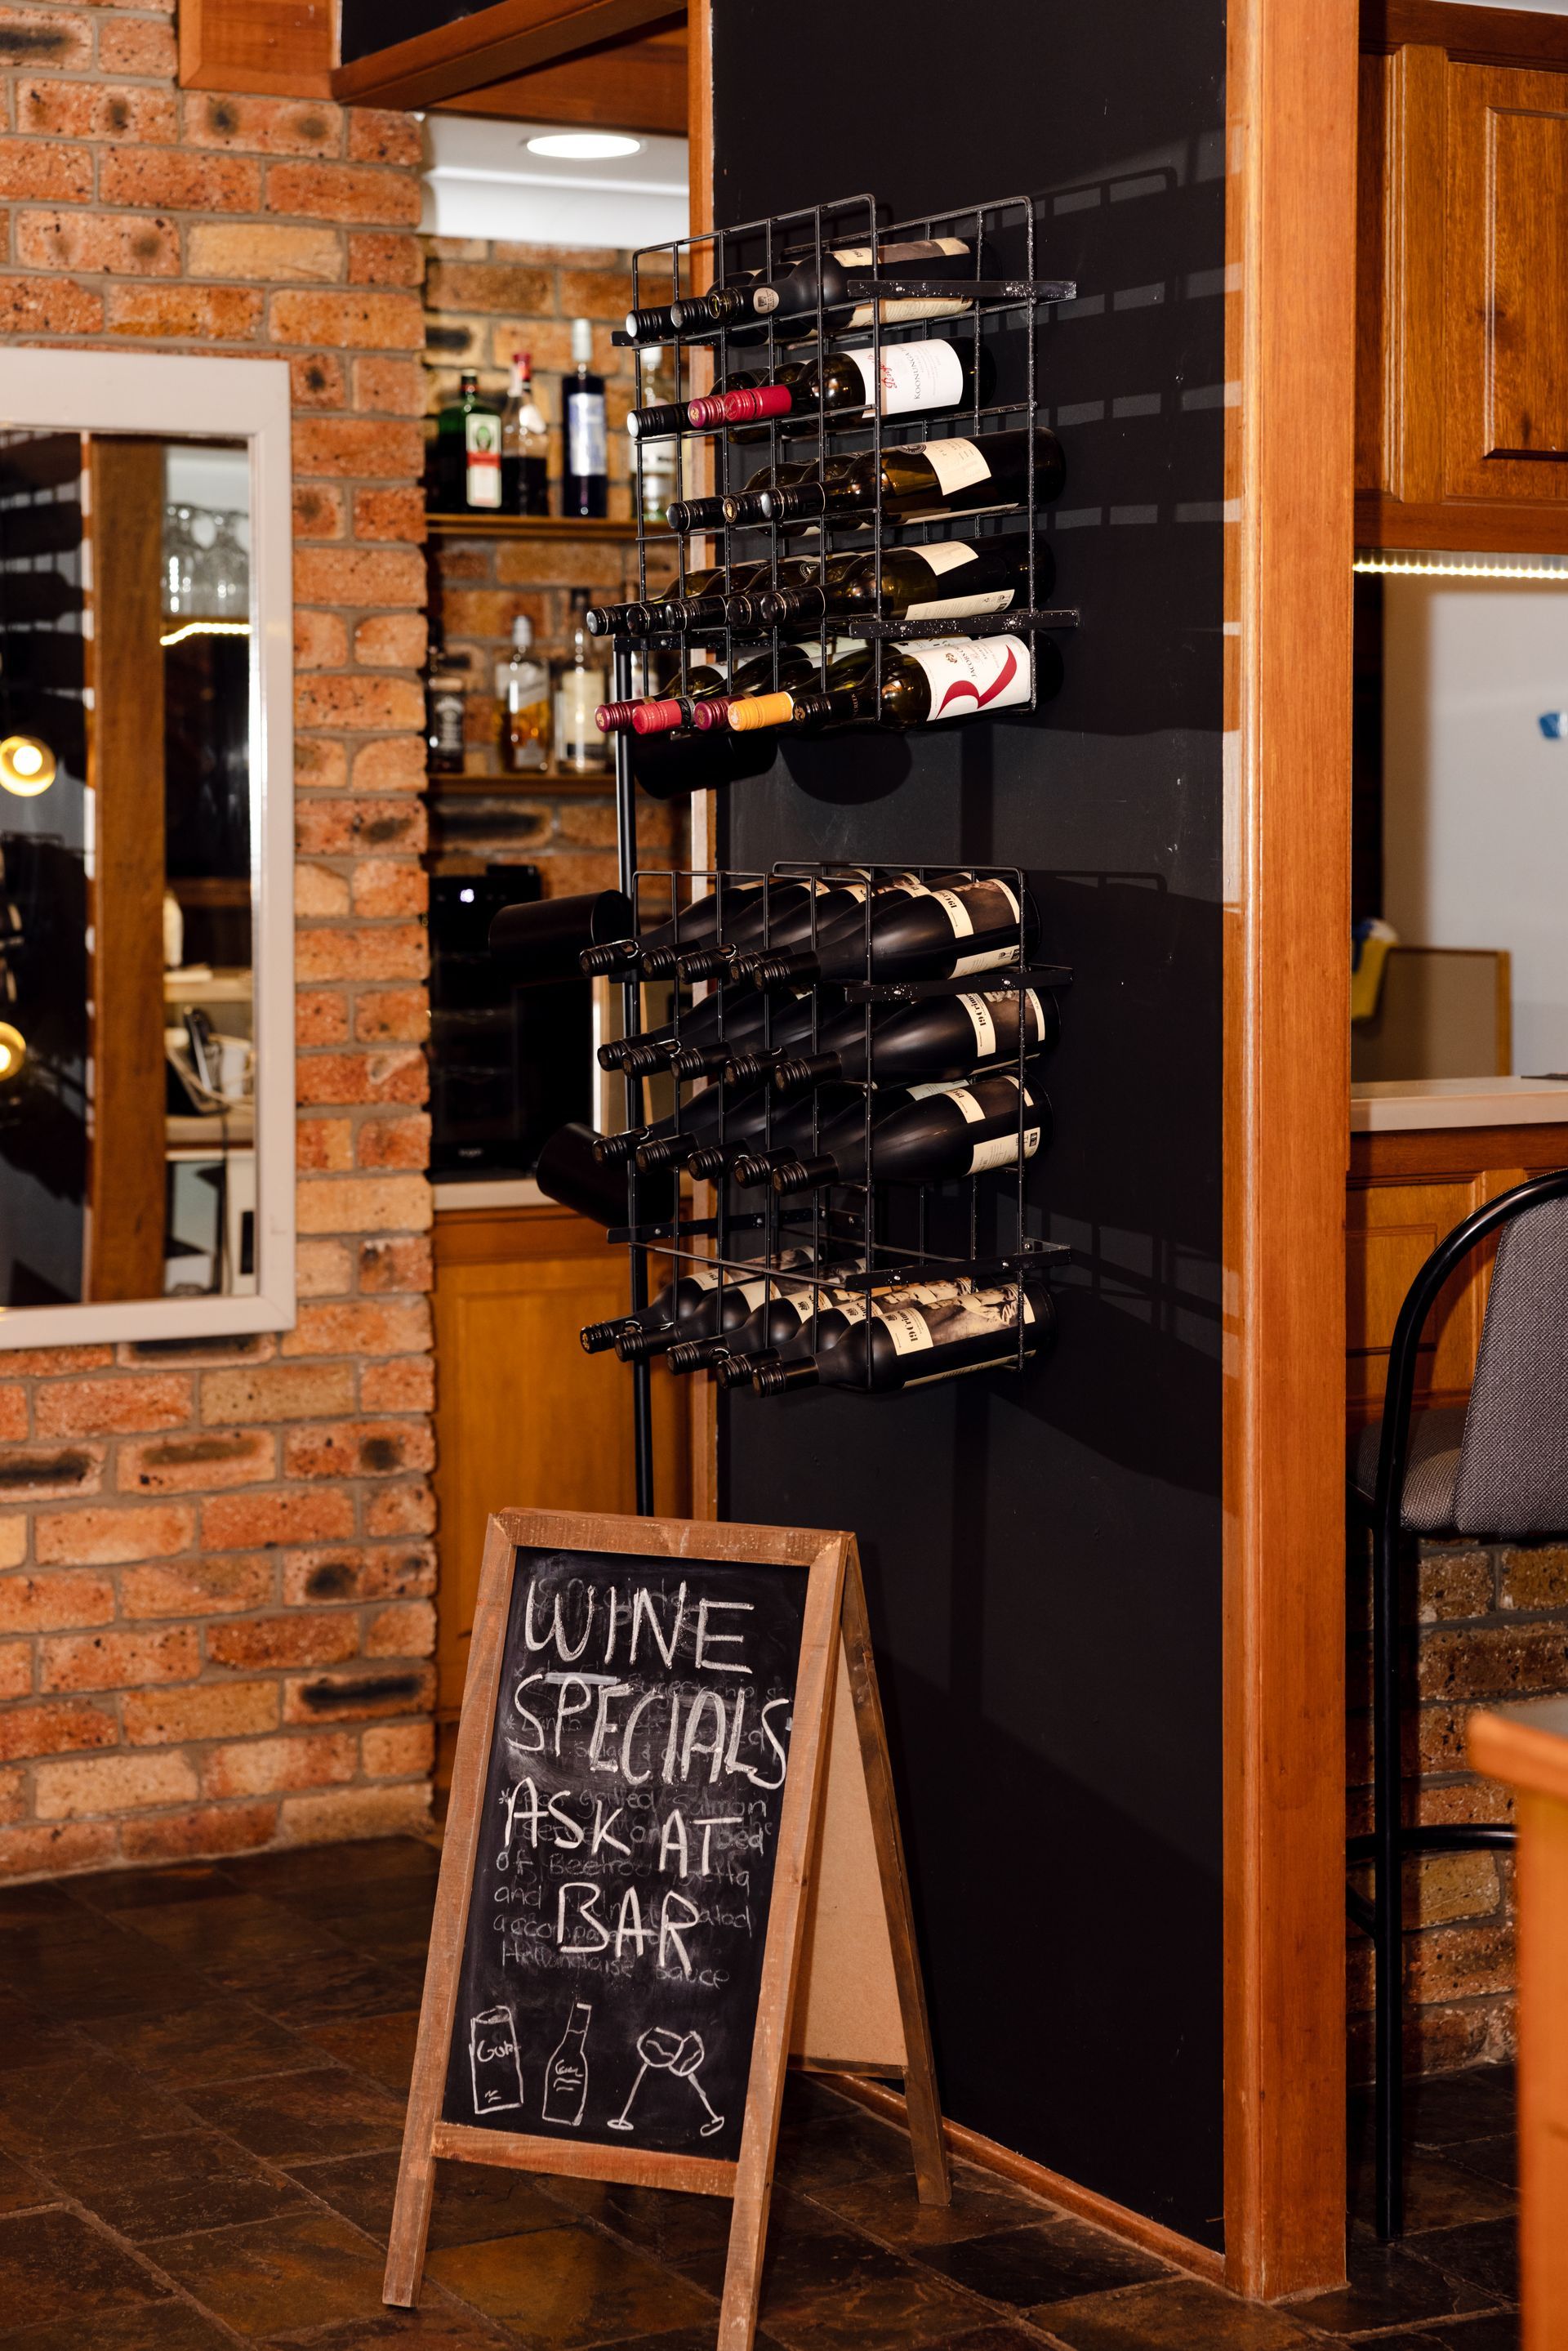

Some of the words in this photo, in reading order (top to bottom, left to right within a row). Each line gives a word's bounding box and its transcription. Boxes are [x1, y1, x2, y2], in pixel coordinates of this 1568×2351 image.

[908, 1330, 919, 1342] 19
[525, 1579, 755, 1673] WINE
[505, 1674, 790, 1790] SPECIALS
[505, 1777, 631, 1855] ASK
[660, 1809, 743, 1878] AT
[558, 1882, 700, 1975] BAR
